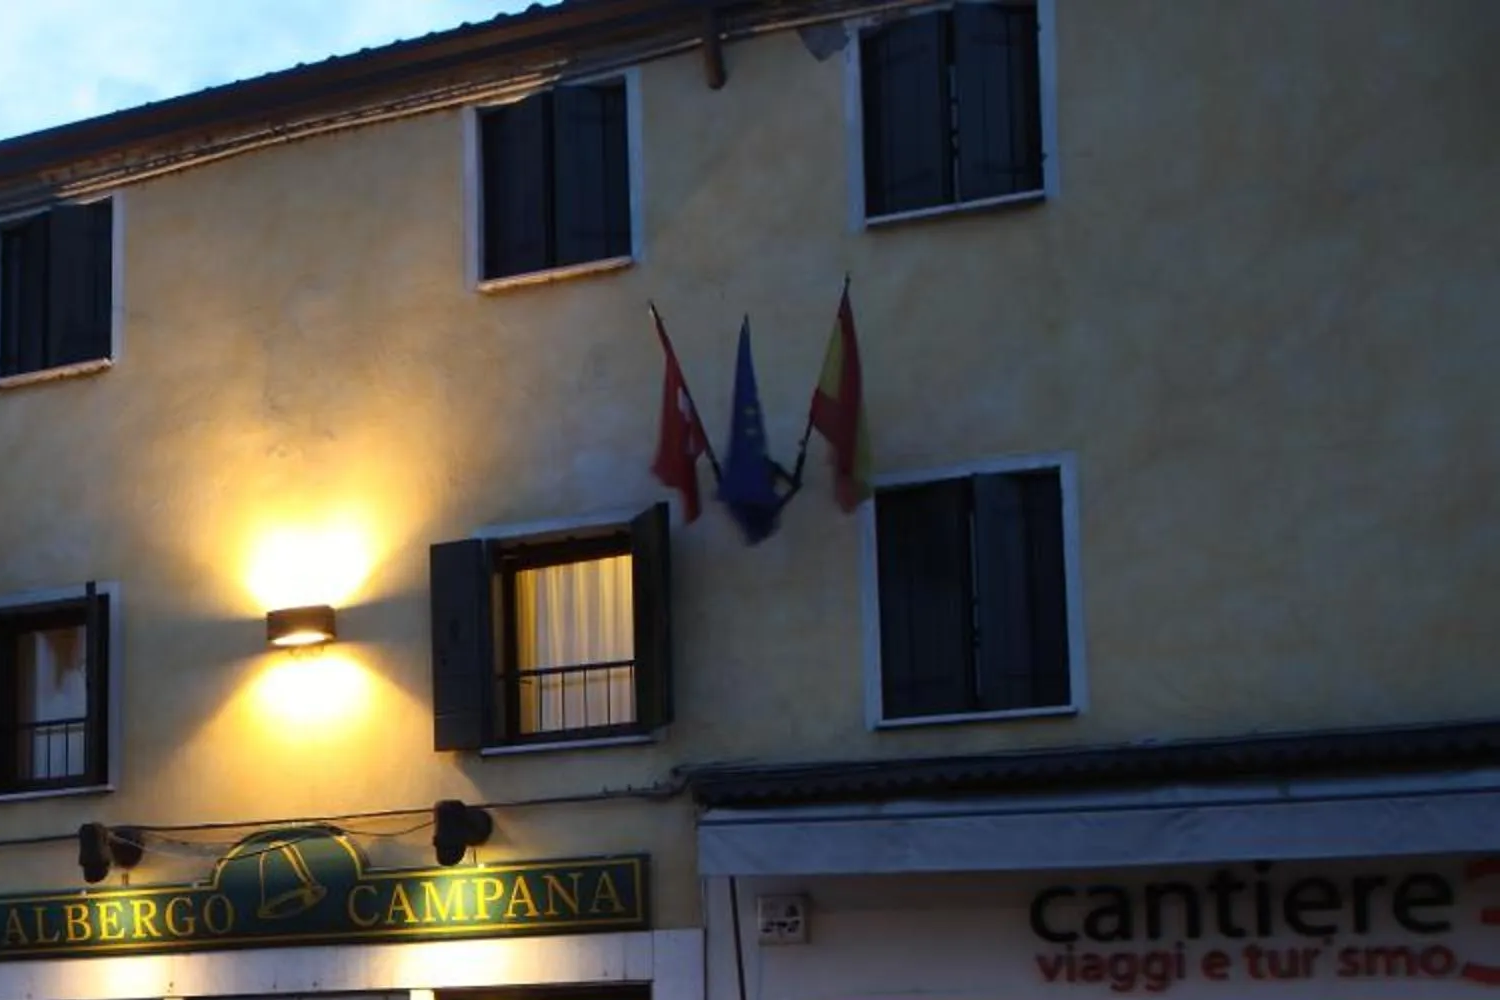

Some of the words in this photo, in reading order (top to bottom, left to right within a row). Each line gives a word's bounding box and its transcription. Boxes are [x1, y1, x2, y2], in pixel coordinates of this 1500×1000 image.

[4, 894, 235, 945] ALBERGO
[349, 870, 625, 927] CAMPANA
[1029, 861, 1453, 943] cantiere
[1036, 942, 1186, 993] viaggi
[1203, 948, 1230, 981] e
